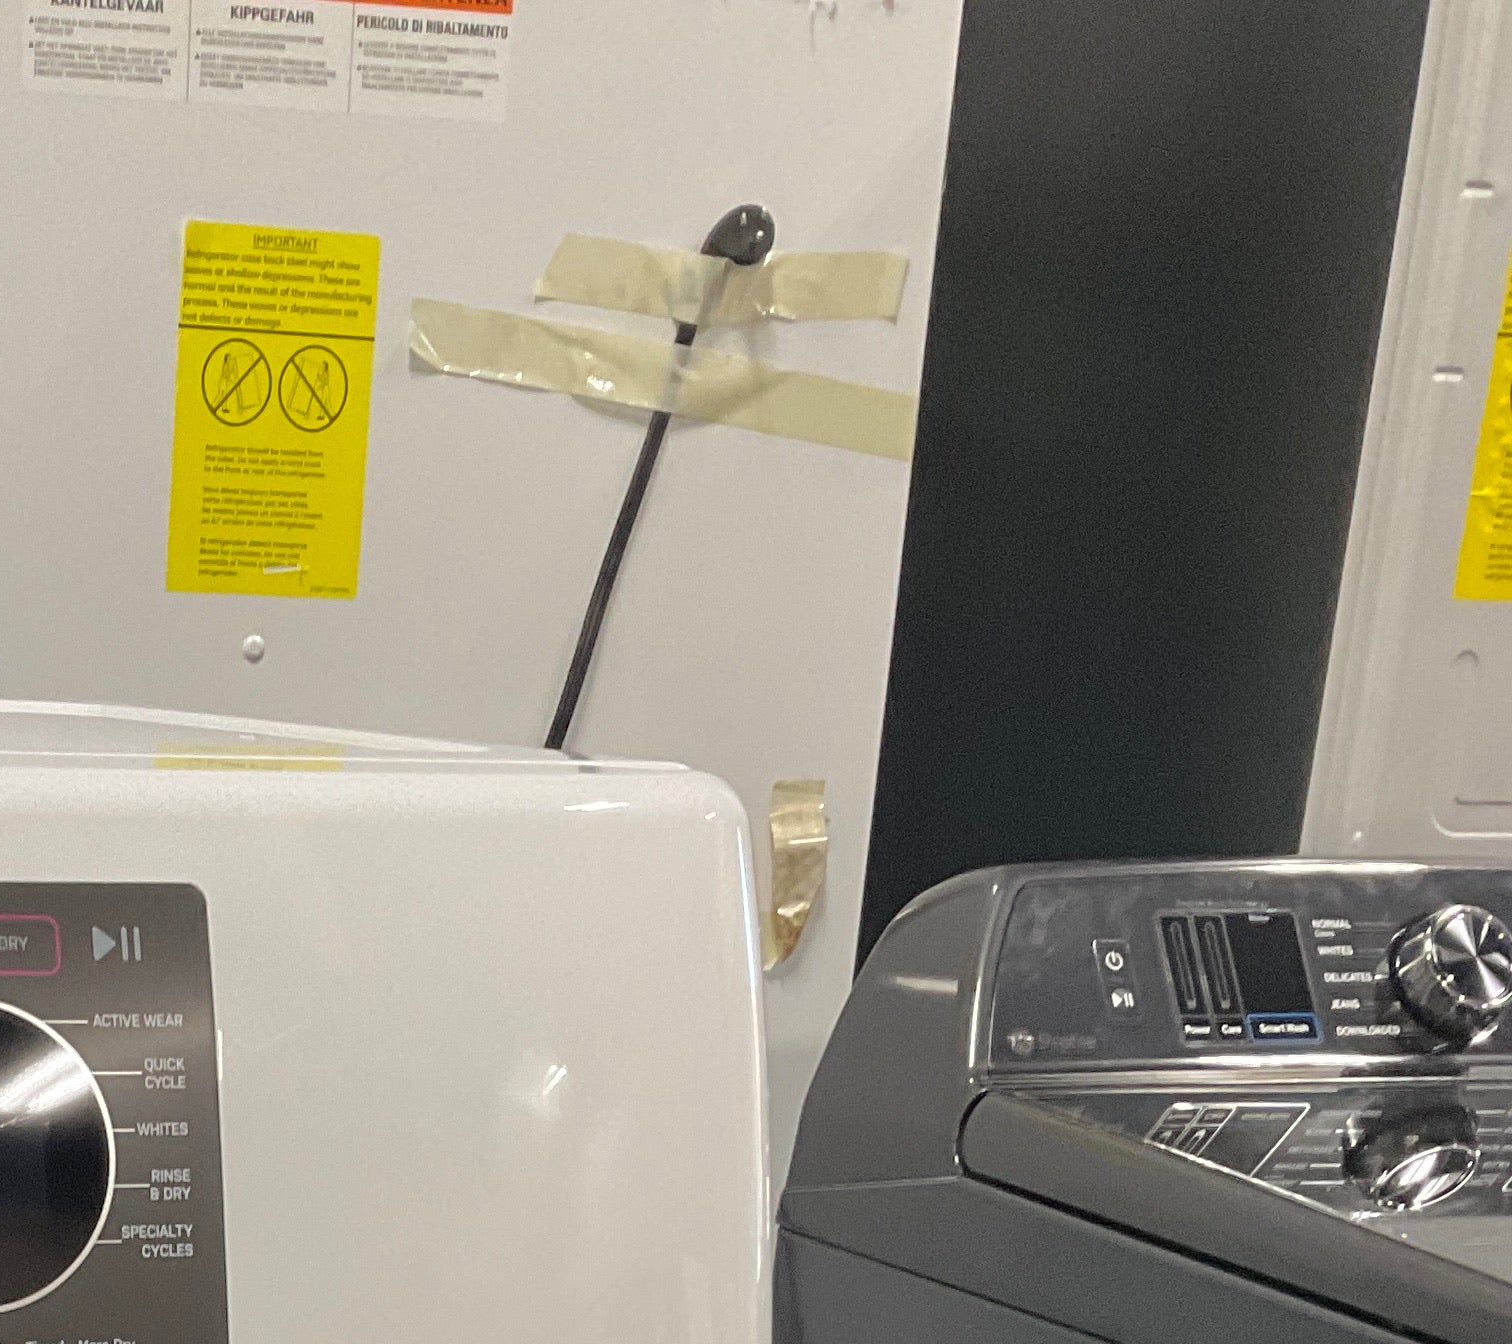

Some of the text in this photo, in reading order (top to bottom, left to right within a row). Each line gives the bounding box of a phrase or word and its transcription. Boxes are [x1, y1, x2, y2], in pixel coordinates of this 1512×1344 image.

[230, 5, 314, 25] KIPPGEFAHR
[356, 15, 408, 32] PERICOLO
[426, 20, 509, 39] RIBALTAMENTO
[253, 233, 318, 251] IMPORTANT
[1324, 971, 1373, 983] DELICATES
[93, 1013, 184, 1028] ACTIVE WEAR
[1336, 1024, 1401, 1036] DOWNLOADED
[144, 1057, 185, 1074] QUICK
[144, 1075, 186, 1089] CYCLE
[136, 1121, 189, 1137] WHITES
[151, 1167, 191, 1183] RINSE
[163, 1185, 192, 1201] DRY
[121, 1223, 193, 1240] SPECIALTY
[141, 1243, 194, 1258] CYCLES
